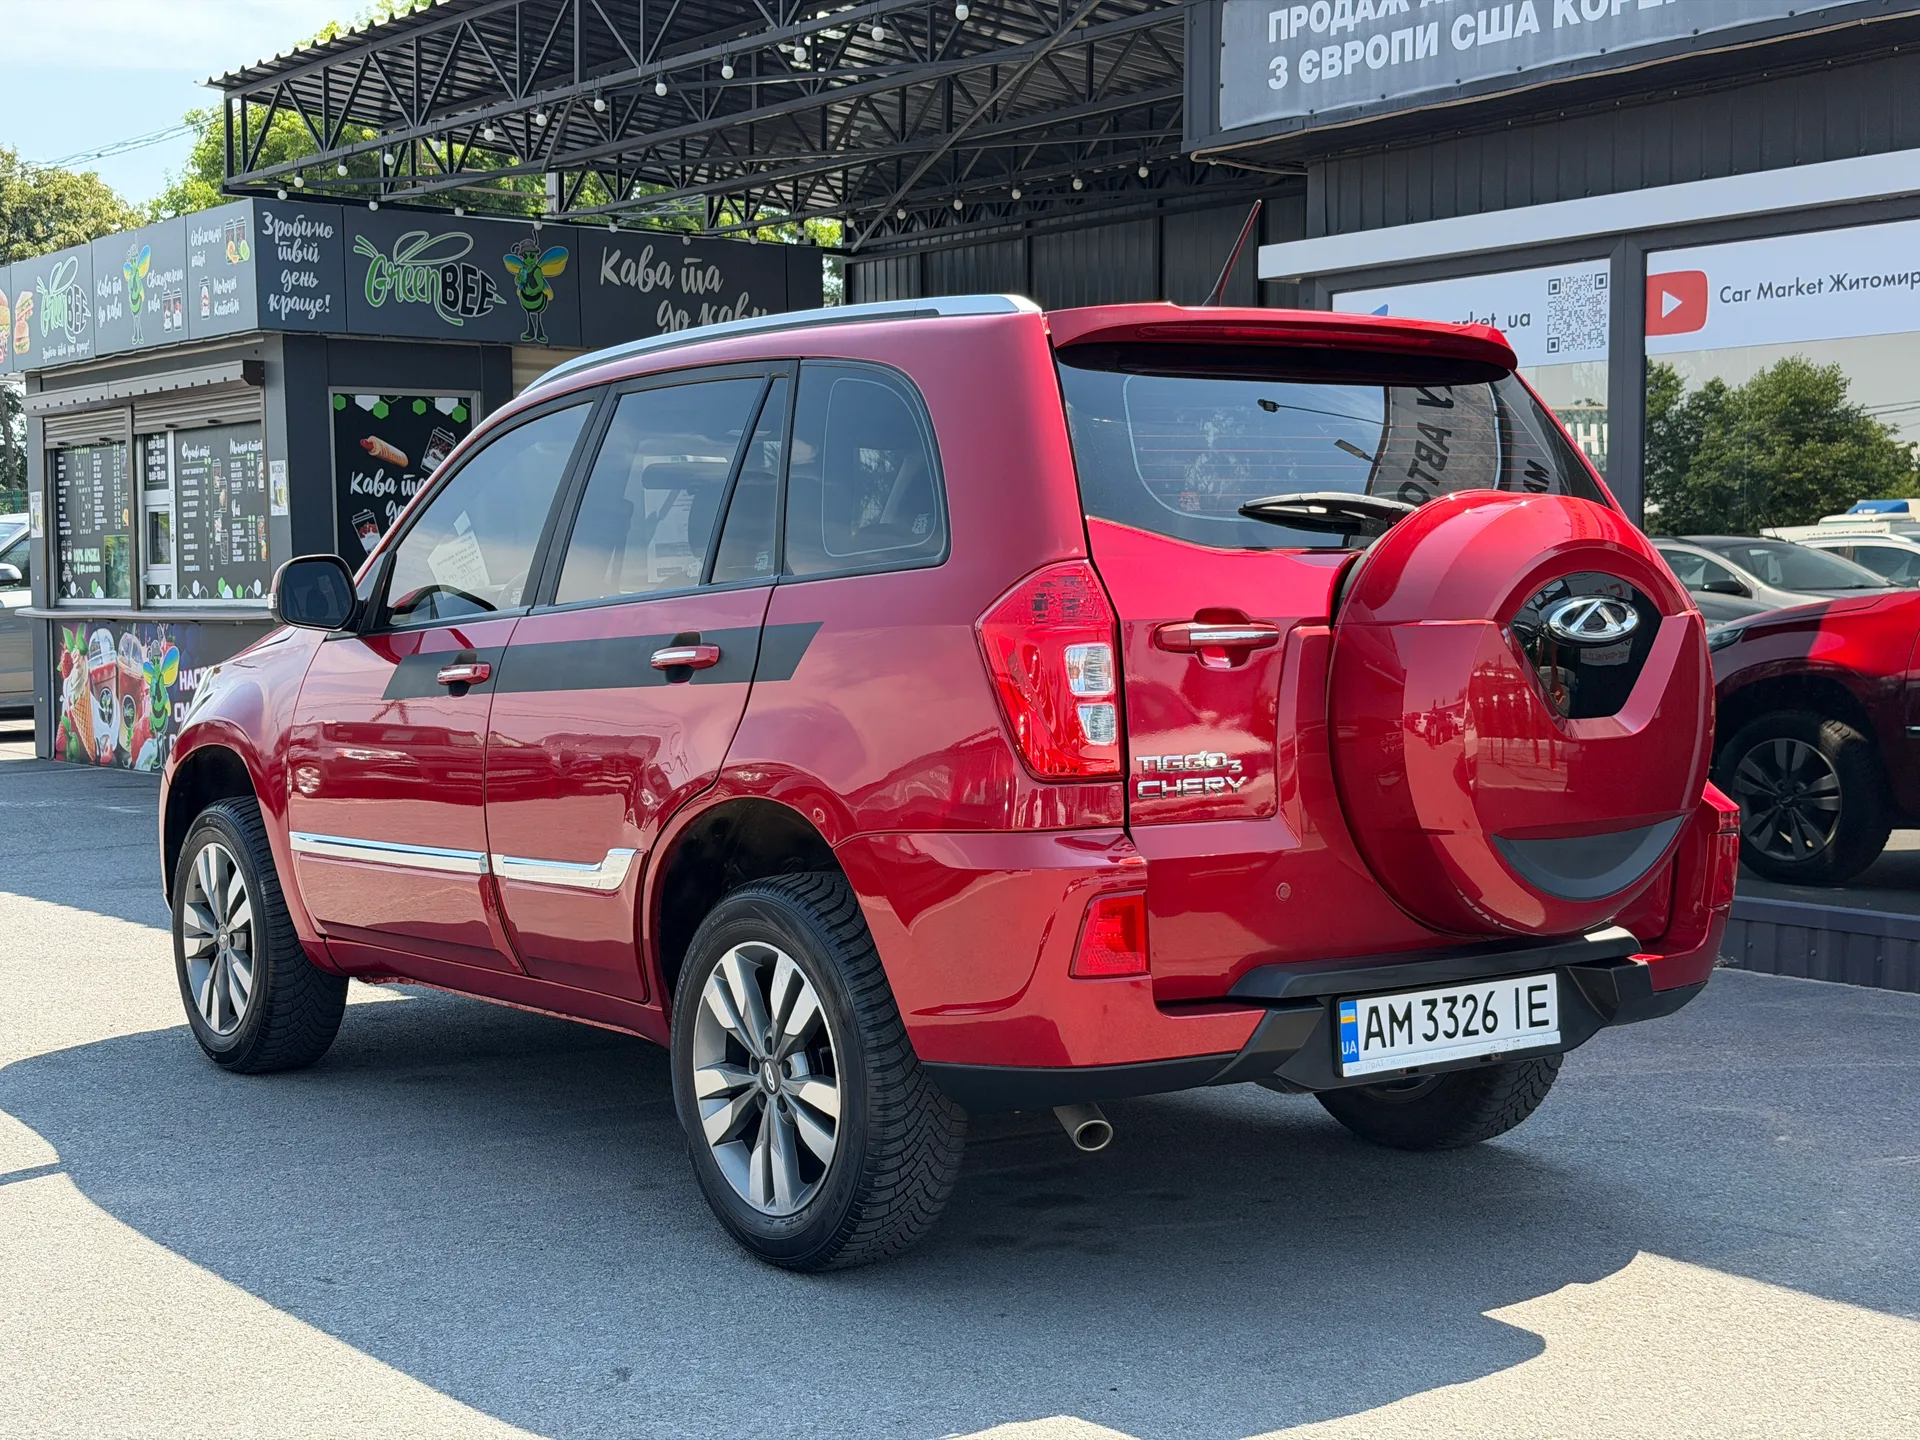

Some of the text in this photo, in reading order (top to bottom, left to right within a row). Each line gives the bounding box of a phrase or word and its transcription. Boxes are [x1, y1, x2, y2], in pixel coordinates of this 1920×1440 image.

[1299, 22, 1438, 84] ЄВРОПИ
[1451, 0, 1540, 51] США
[262, 211, 334, 245] Зробимо
[278, 238, 320, 264] твій
[281, 269, 319, 293] день
[600, 244, 724, 295] Кава та
[1720, 269, 1920, 304] Car Market Житомир
[268, 293, 331, 321] краще!
[656, 299, 691, 334] до
[350, 468, 398, 498] Кава
[1137, 776, 1248, 800] CHERY
[1341, 1041, 1358, 1055] UA
[1363, 1001, 1414, 1051] AM
[1421, 990, 1499, 1042] 3326
[1514, 983, 1551, 1030] IE
